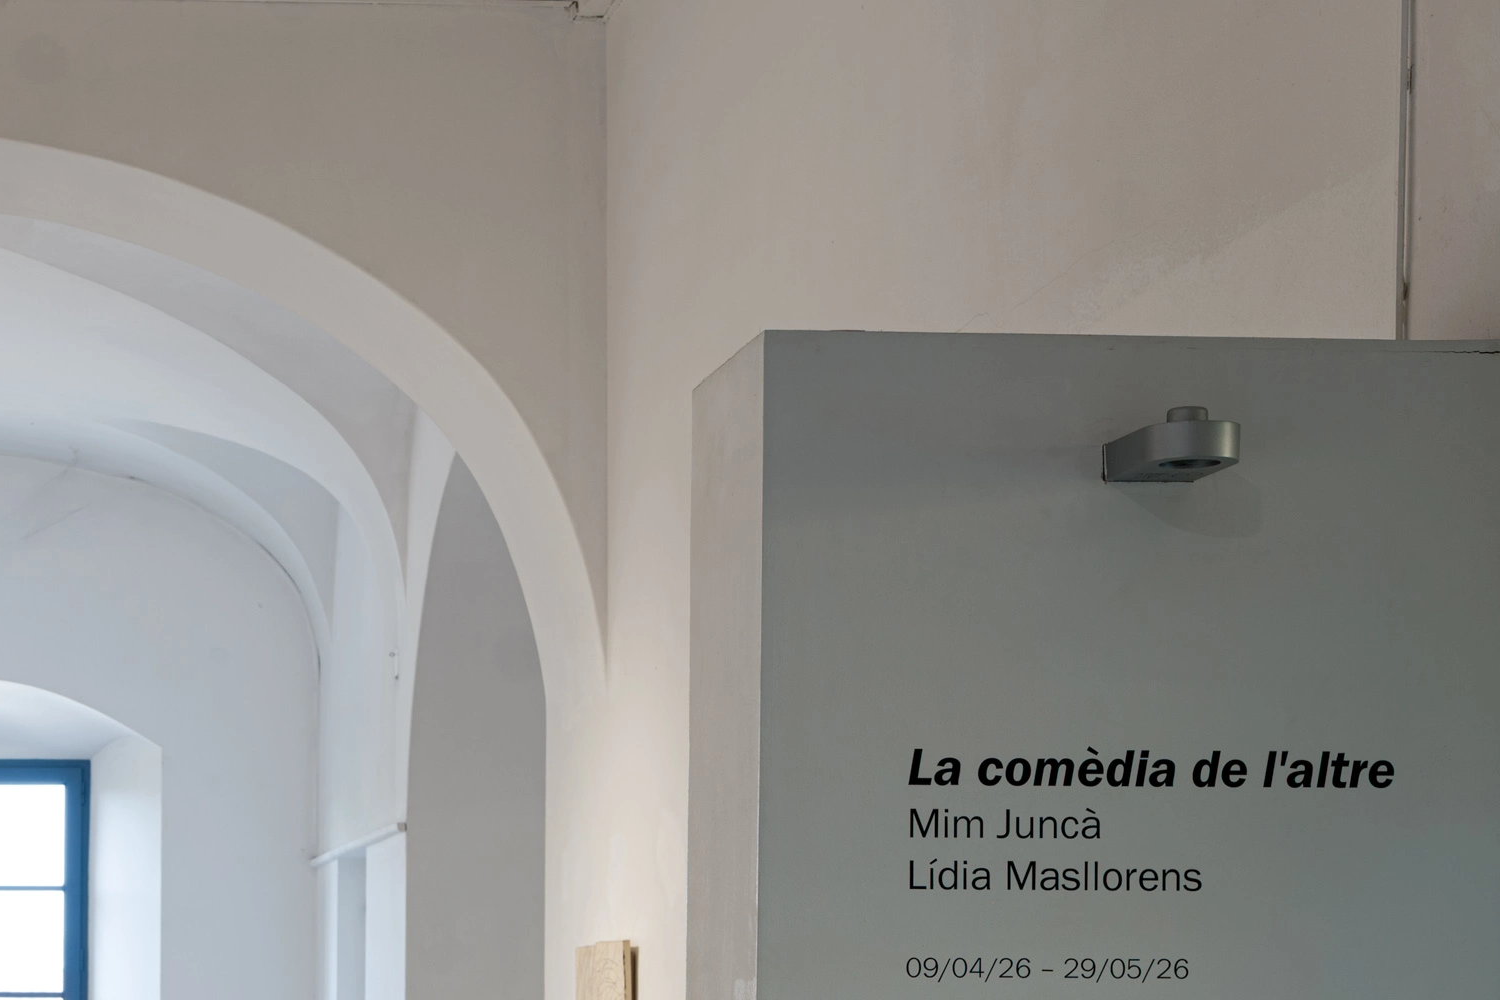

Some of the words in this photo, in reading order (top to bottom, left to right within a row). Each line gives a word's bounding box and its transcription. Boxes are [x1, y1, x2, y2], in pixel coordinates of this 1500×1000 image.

[908, 749, 961, 787] La
[978, 746, 1175, 788] comèdia
[1192, 751, 1247, 789] de
[1263, 751, 1394, 789] l'altre
[909, 808, 984, 839] Mim
[997, 808, 1101, 840] Juncà
[908, 858, 991, 891] Lídia
[1006, 860, 1202, 892] Masllorens
[906, 957, 1031, 983] 09/04/26
[1063, 957, 1189, 983] 29/05/26
